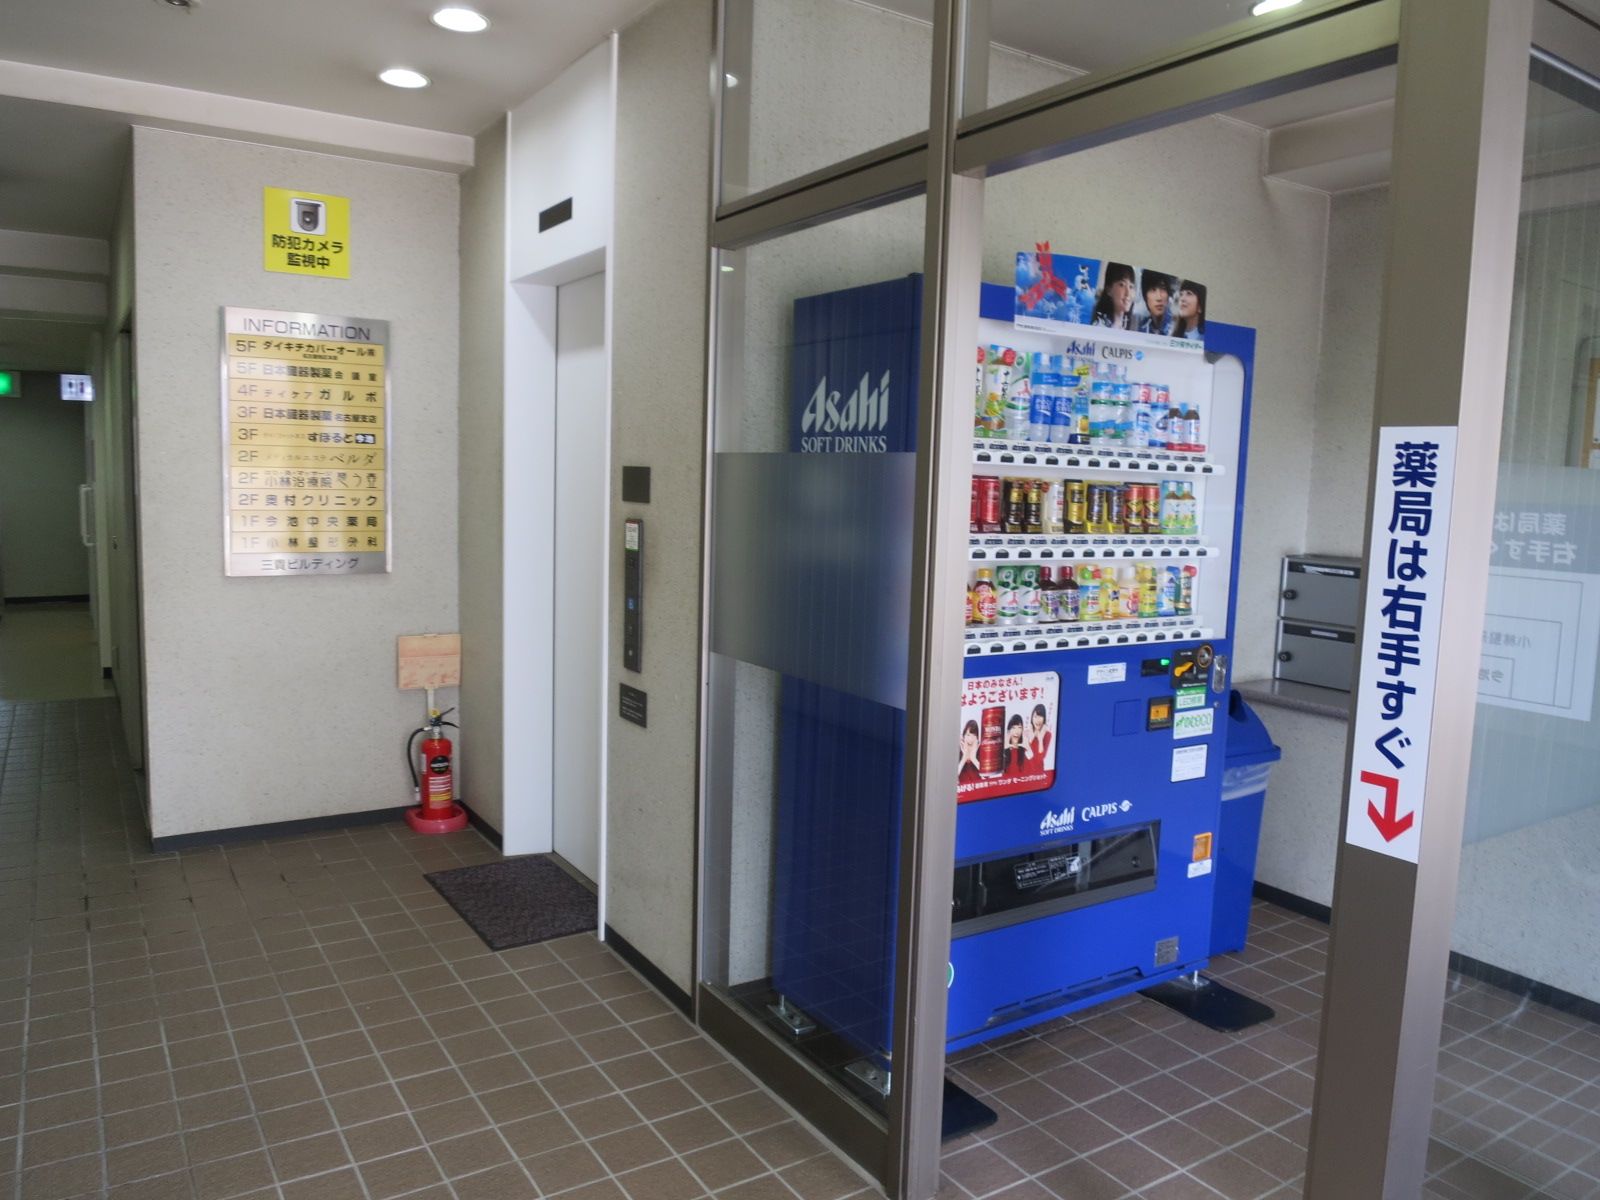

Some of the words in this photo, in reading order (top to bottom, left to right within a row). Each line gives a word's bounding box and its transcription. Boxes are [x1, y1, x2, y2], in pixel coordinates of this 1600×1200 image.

[272, 234, 343, 253] 防犯カメラ
[287, 252, 330, 269] 監視中
[243, 318, 371, 341] INFORMATION
[236, 340, 256, 352] 5F
[1066, 340, 1096, 356] Asahi
[1101, 345, 1133, 359] CALPIS
[236, 361, 257, 375] 5F
[237, 384, 258, 397] 4F
[801, 368, 890, 433] Asahi
[237, 406, 257, 419] 3F
[238, 428, 258, 441] 3F
[801, 436, 832, 453] SOFT
[834, 435, 887, 453] DRINKS
[238, 450, 259, 462] 2F
[238, 472, 259, 484] 2F
[238, 494, 259, 506] 2F
[265, 494, 377, 506] 奥村クリニック
[241, 515, 260, 527] 1F
[265, 515, 378, 528] 今池中央薬局
[241, 537, 260, 548] 1F
[1374, 441, 1439, 770] 薬局は右手すぐ
[1040, 806, 1075, 830] Asahi
[1081, 802, 1118, 822] CALPIS
